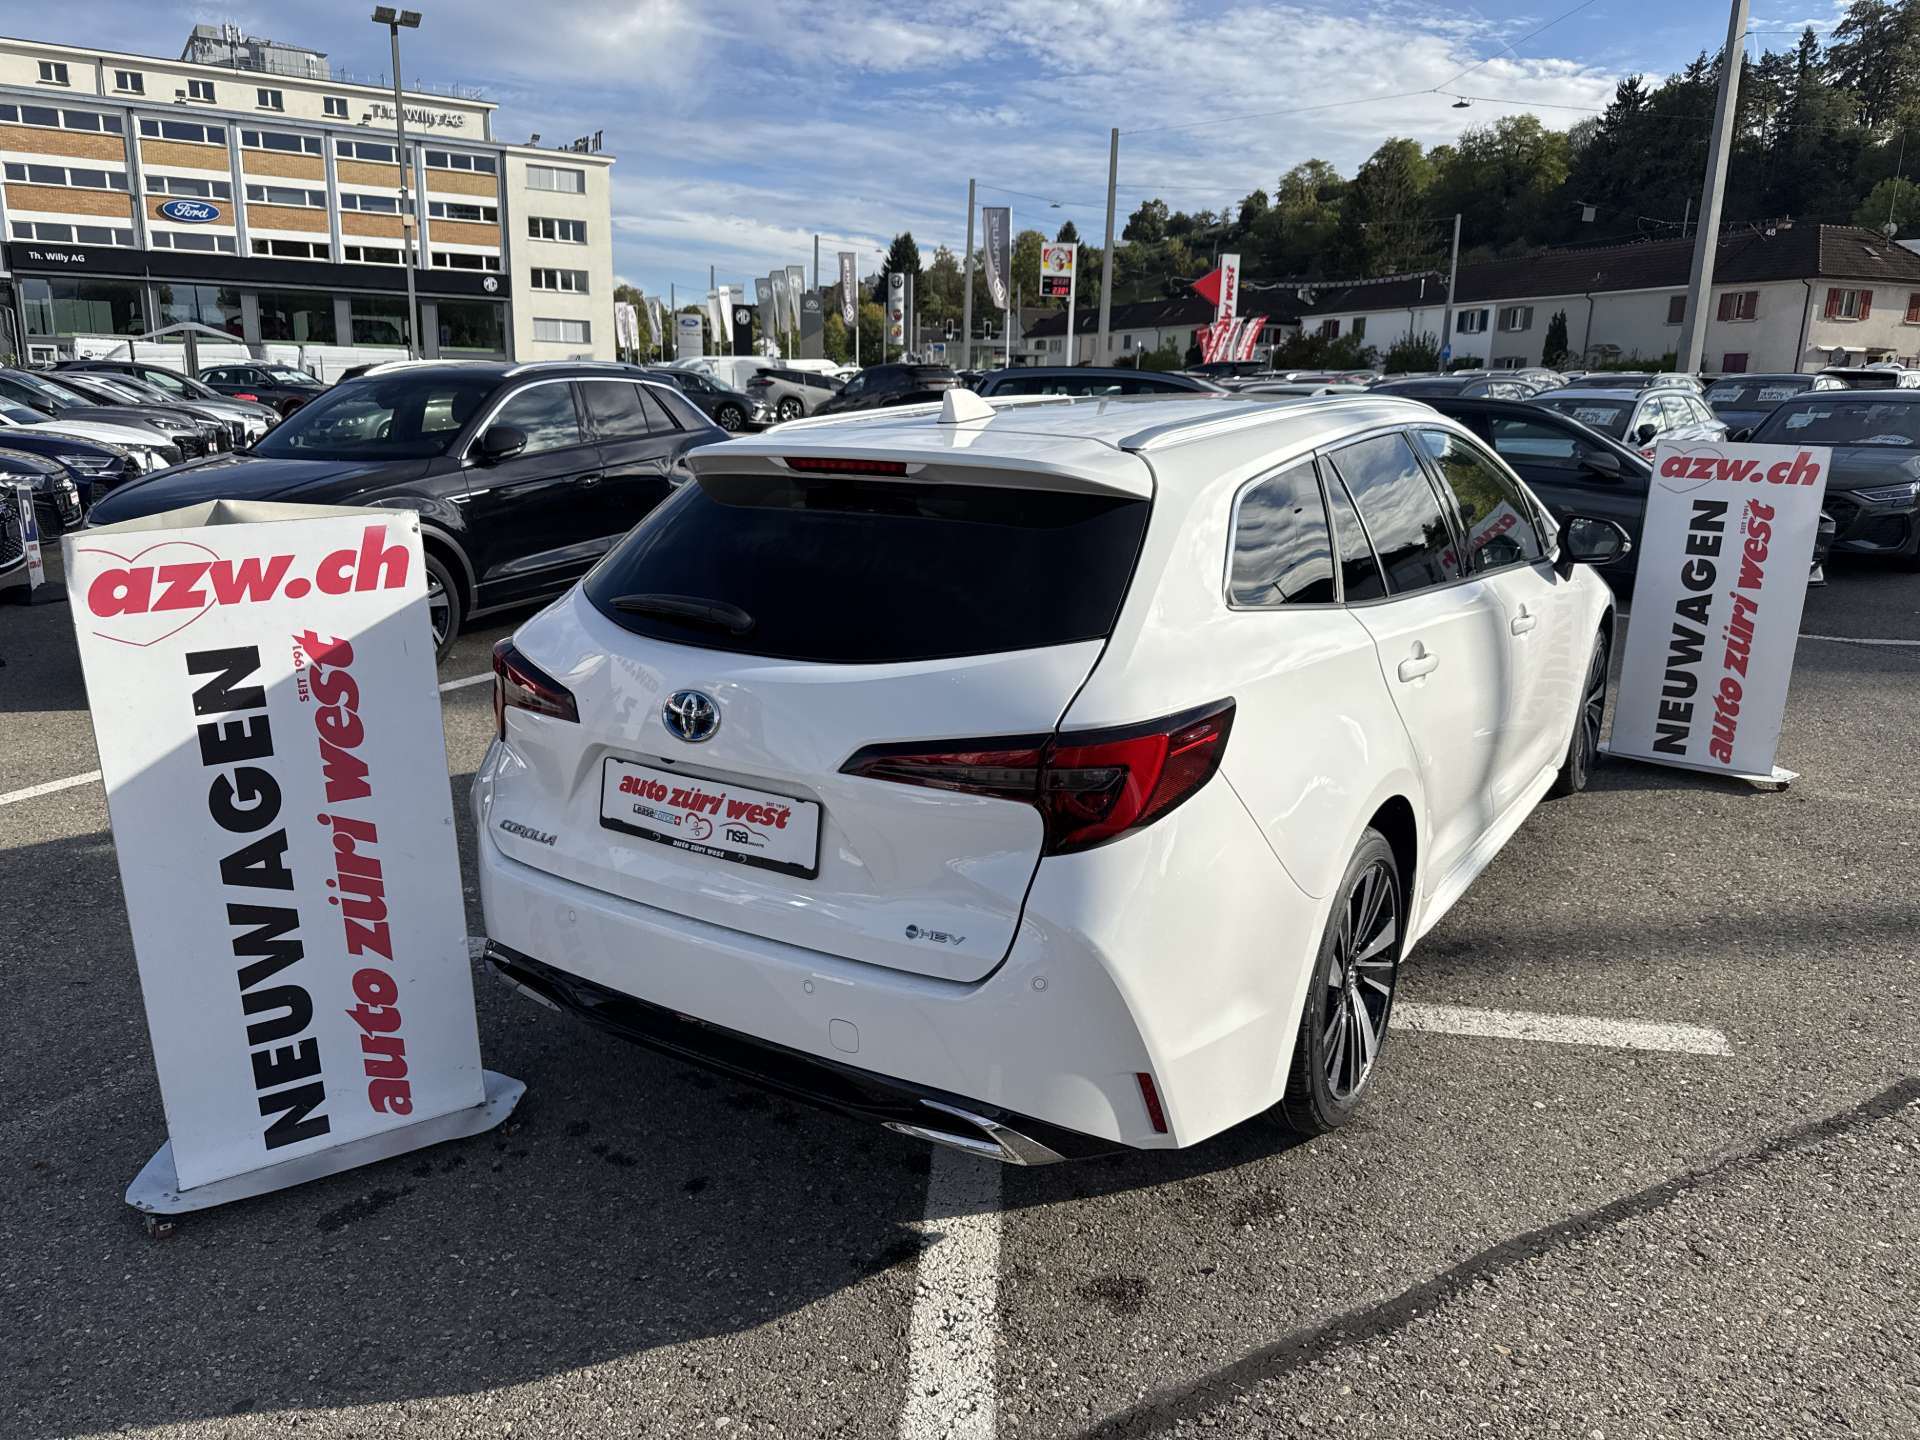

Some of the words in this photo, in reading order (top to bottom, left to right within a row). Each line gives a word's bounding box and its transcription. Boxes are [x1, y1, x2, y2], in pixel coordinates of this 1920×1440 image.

[174, 203, 209, 219] Ford
[28, 252, 43, 261] Th.
[46, 253, 69, 263] Willy
[71, 254, 85, 263] AG
[1223, 265, 1235, 301] west
[1660, 451, 1821, 486] azw.ch
[1737, 498, 1775, 590] west
[87, 526, 410, 618] azw.ch
[1653, 499, 1729, 756] NEUWAGEN
[1722, 591, 1757, 679] züri
[292, 645, 306, 673] 1991
[297, 678, 310, 702] SEIT
[291, 629, 373, 801] west
[1709, 678, 1742, 764] auto
[619, 775, 668, 802] auto
[667, 786, 727, 815] züri
[726, 799, 791, 830] west
[500, 820, 558, 847] COROLLA
[672, 839, 689, 850] auto
[707, 846, 725, 858] west
[726, 828, 749, 844] nsa
[186, 645, 331, 1151] NEUWAGEN
[316, 814, 395, 961] züri
[919, 928, 967, 946] HEV
[344, 970, 414, 1117] auto
